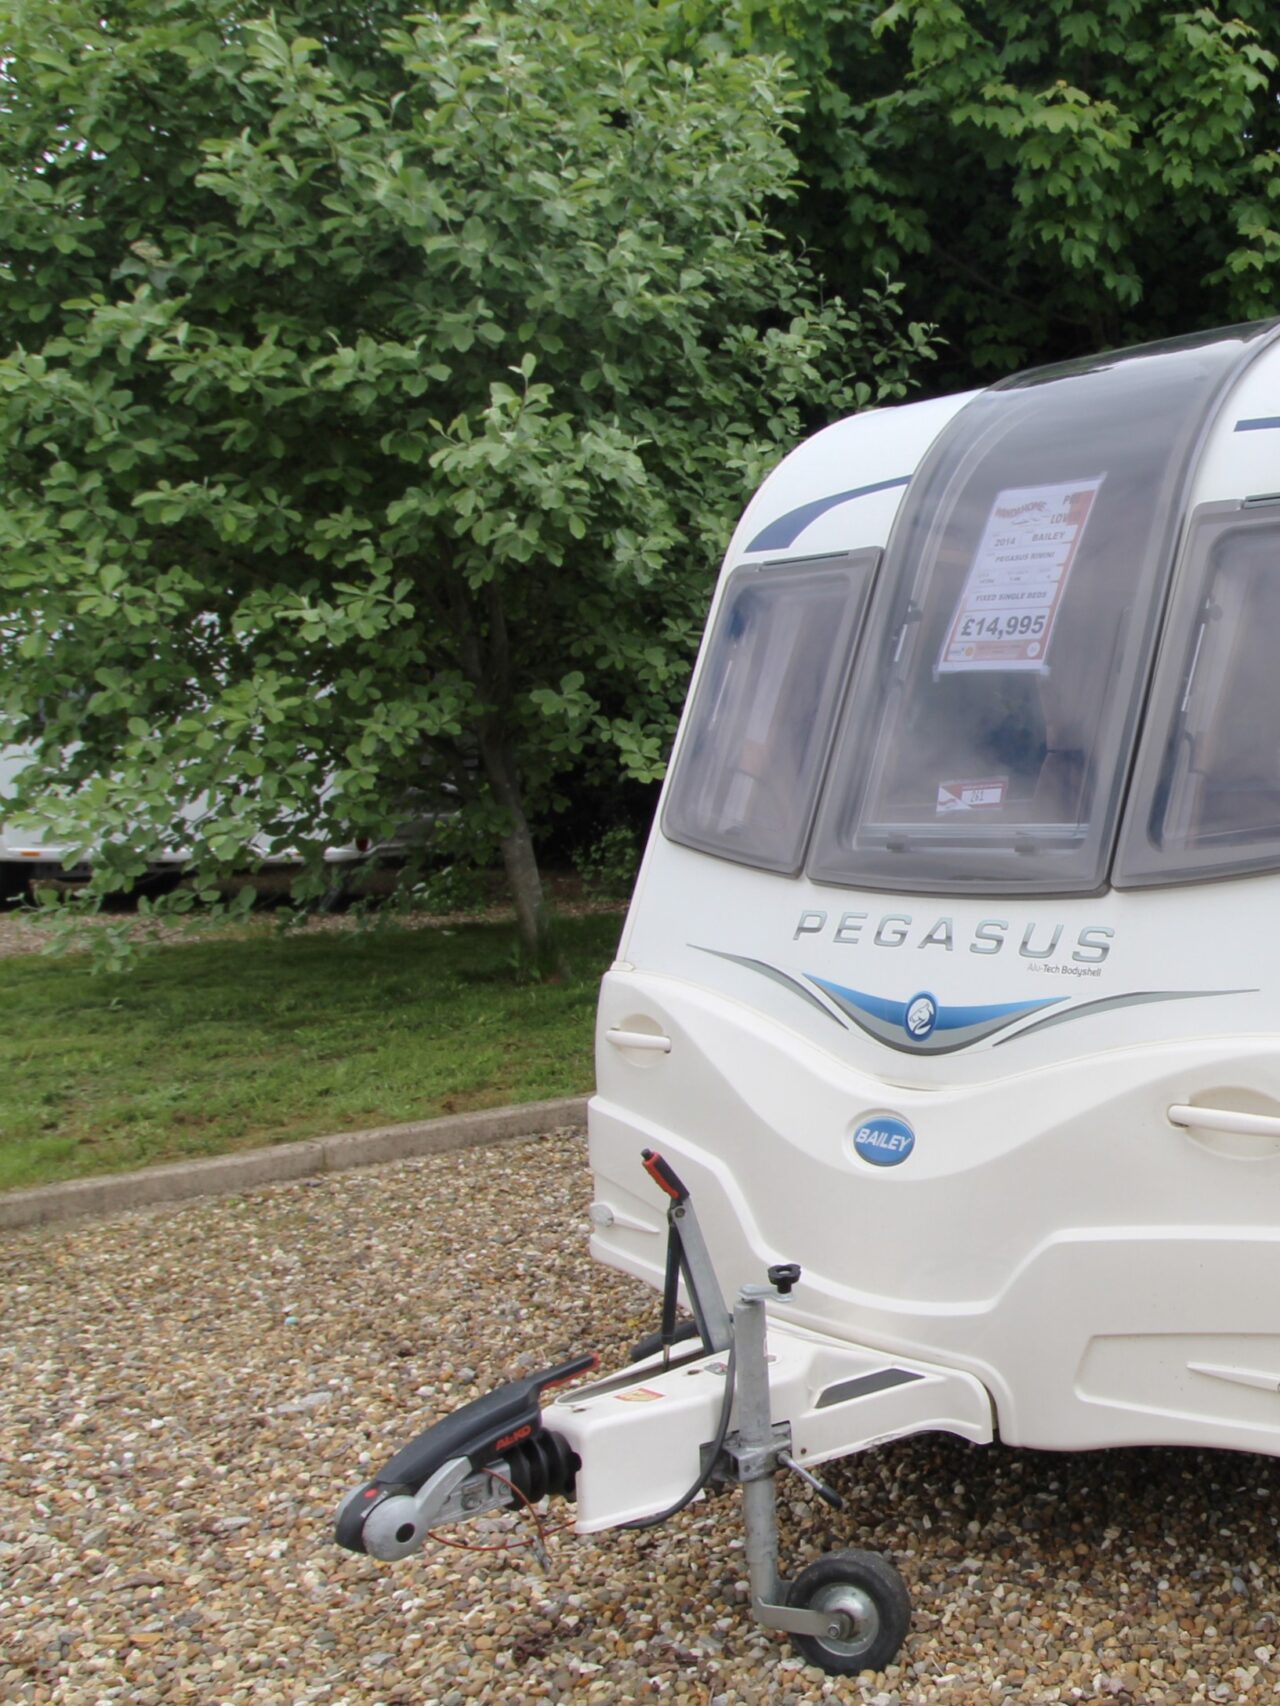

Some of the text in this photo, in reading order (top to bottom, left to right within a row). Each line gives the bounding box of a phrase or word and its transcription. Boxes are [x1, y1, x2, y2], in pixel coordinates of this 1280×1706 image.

[994, 531, 1066, 547] 2014 BAILEY
[995, 552, 1029, 563] PEGASUS
[976, 591, 1048, 602] FIXED SINGLE BEDS
[961, 615, 1046, 639] £14,995
[793, 910, 1116, 964] PEGASUS
[1061, 965, 1102, 978] Bodyshell
[855, 1128, 912, 1152] BAILEY
